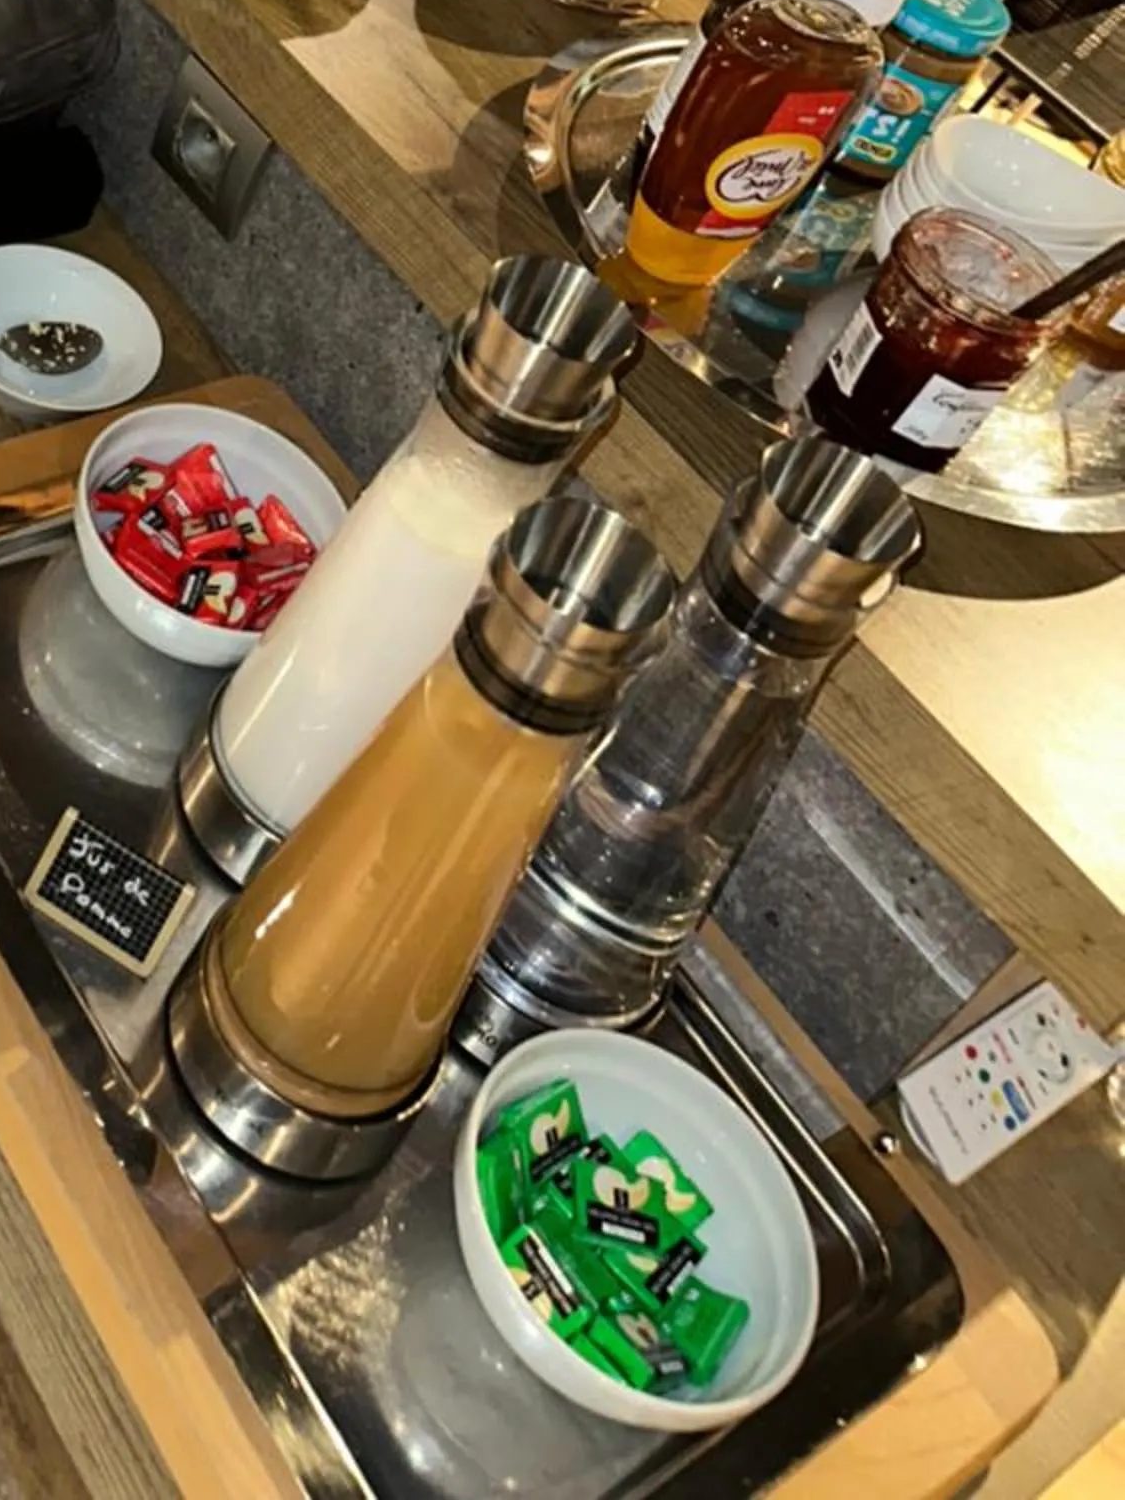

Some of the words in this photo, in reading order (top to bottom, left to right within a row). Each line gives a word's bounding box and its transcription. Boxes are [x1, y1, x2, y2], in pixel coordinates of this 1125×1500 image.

[68, 833, 115, 874] Jus
[124, 877, 150, 906] de
[61, 872, 132, 939] Pomme
